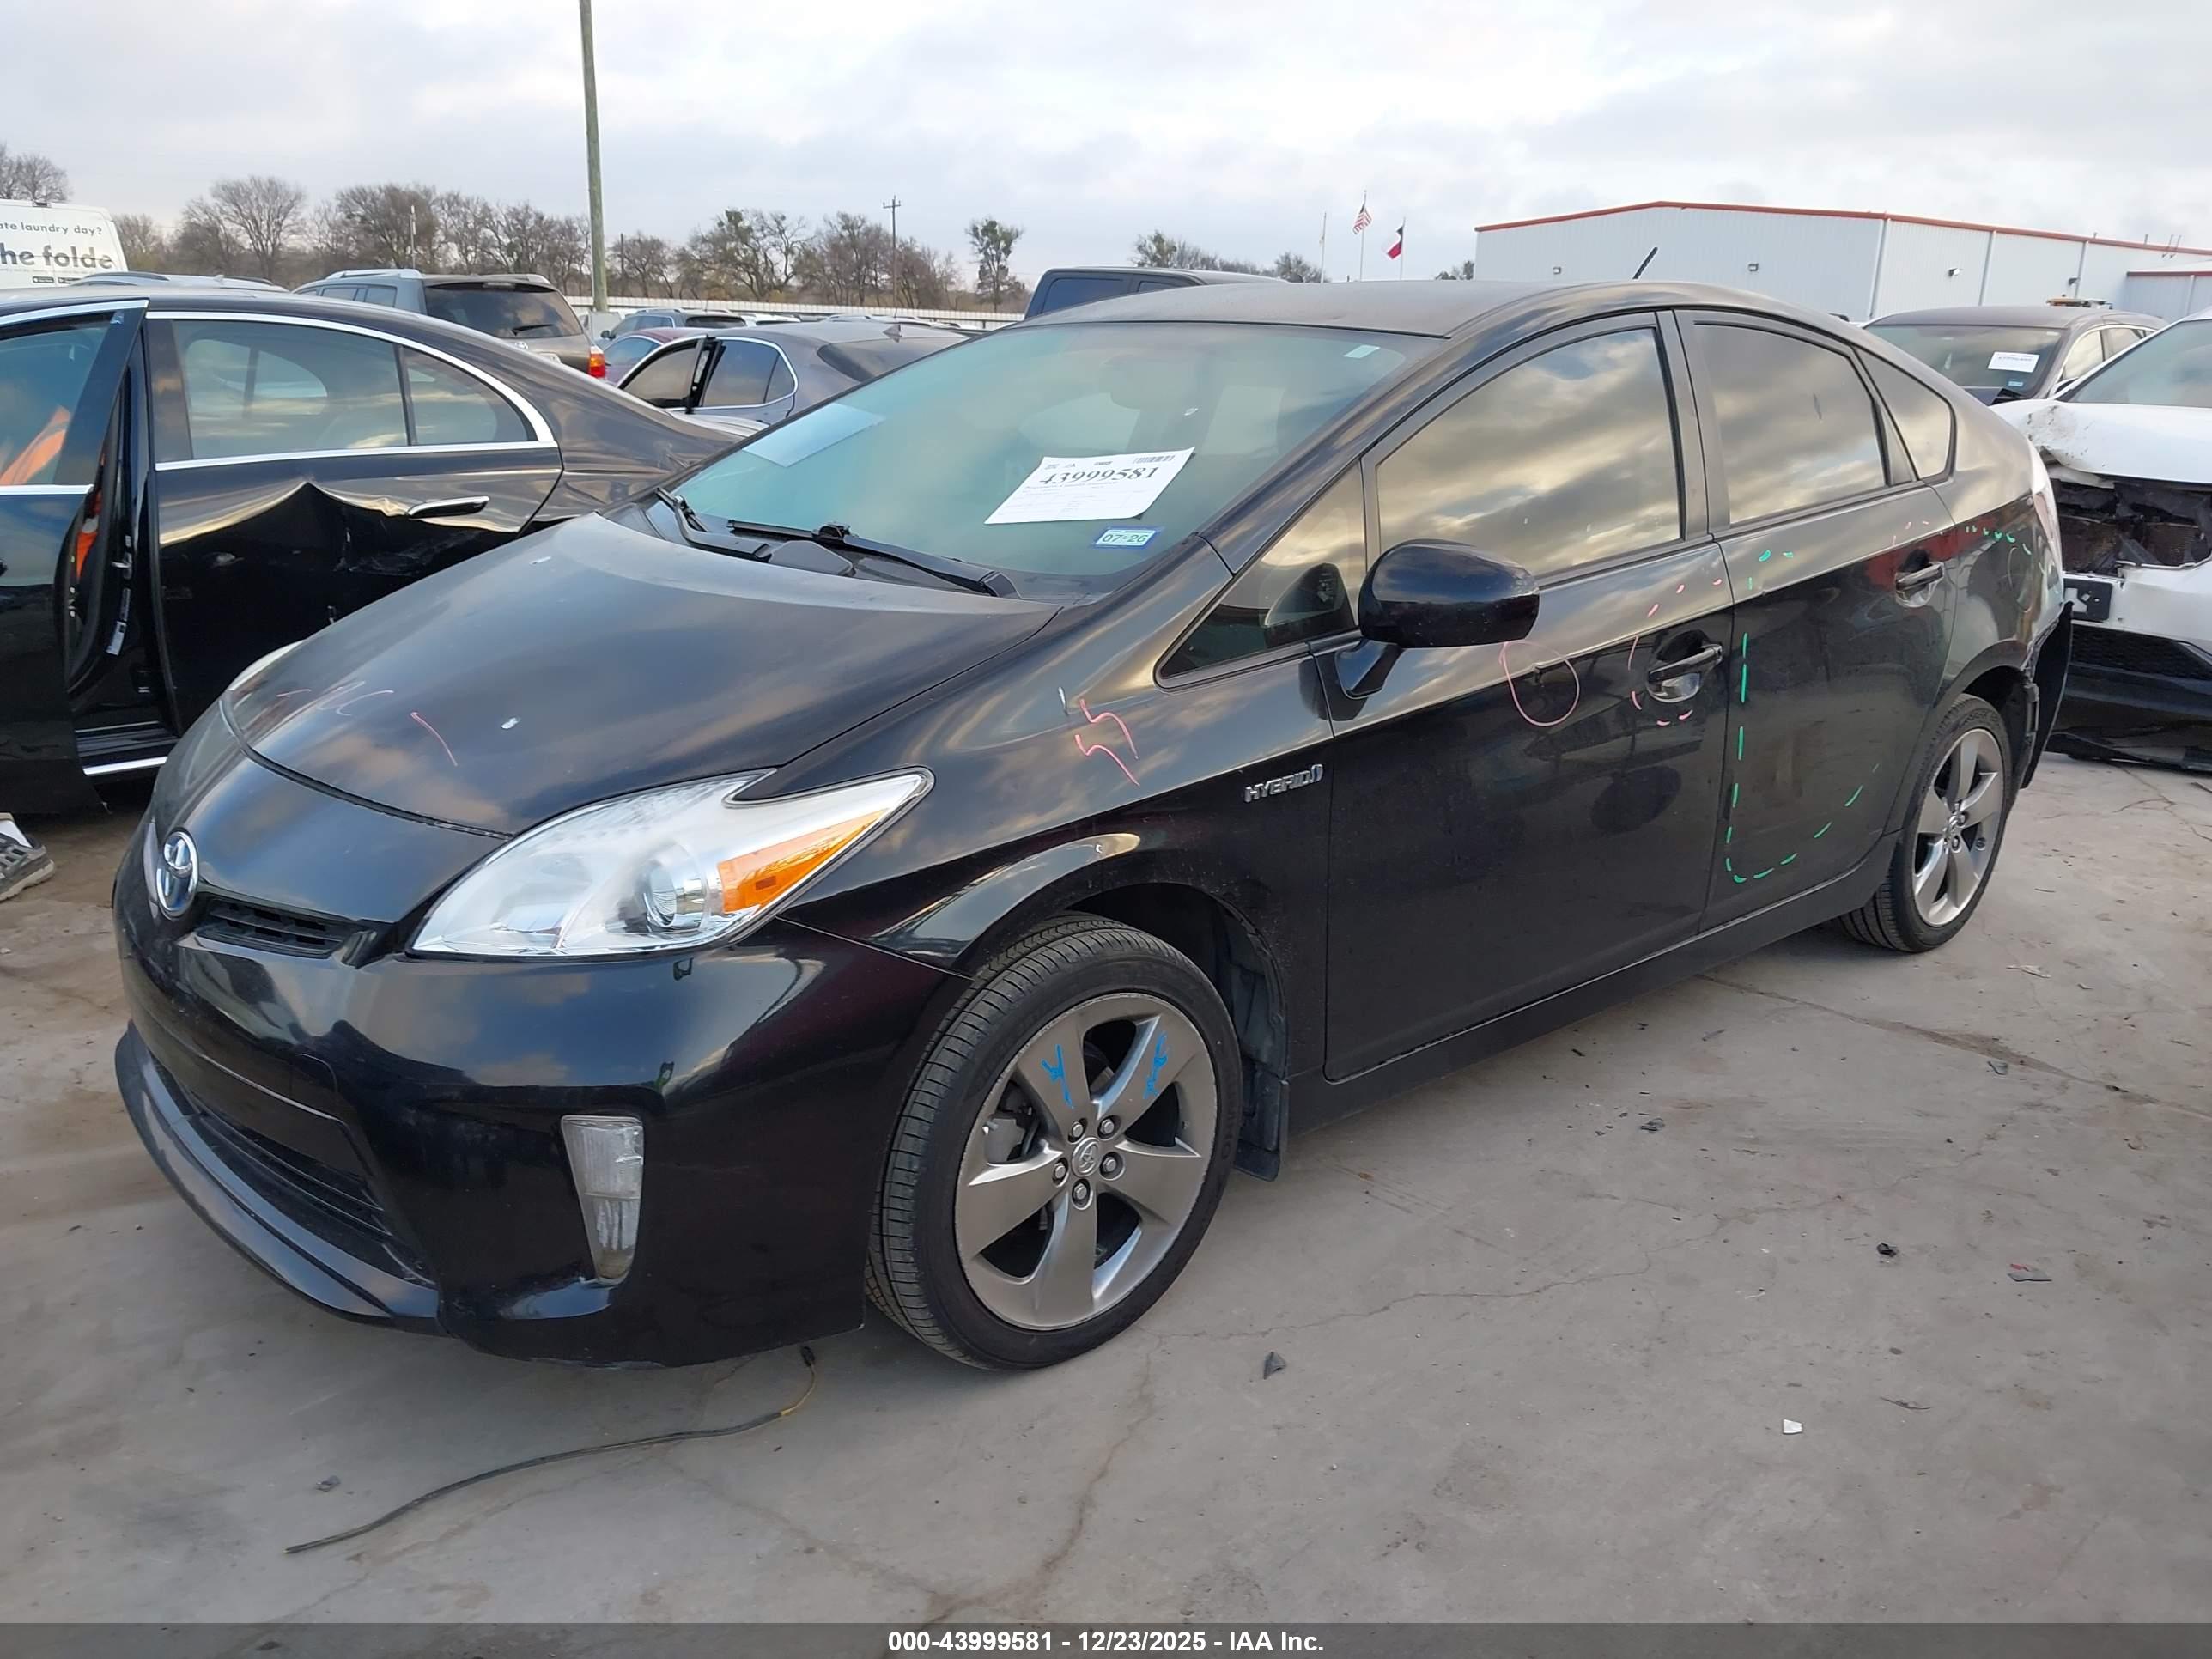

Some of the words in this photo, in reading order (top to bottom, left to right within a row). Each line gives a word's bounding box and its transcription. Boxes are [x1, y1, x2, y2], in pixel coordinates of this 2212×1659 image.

[21, 222, 69, 234] laundry
[74, 225, 102, 236] day?
[42, 244, 112, 270] folde
[1039, 466, 1159, 485] 43999581
[1244, 770, 1311, 803] HYBRID
